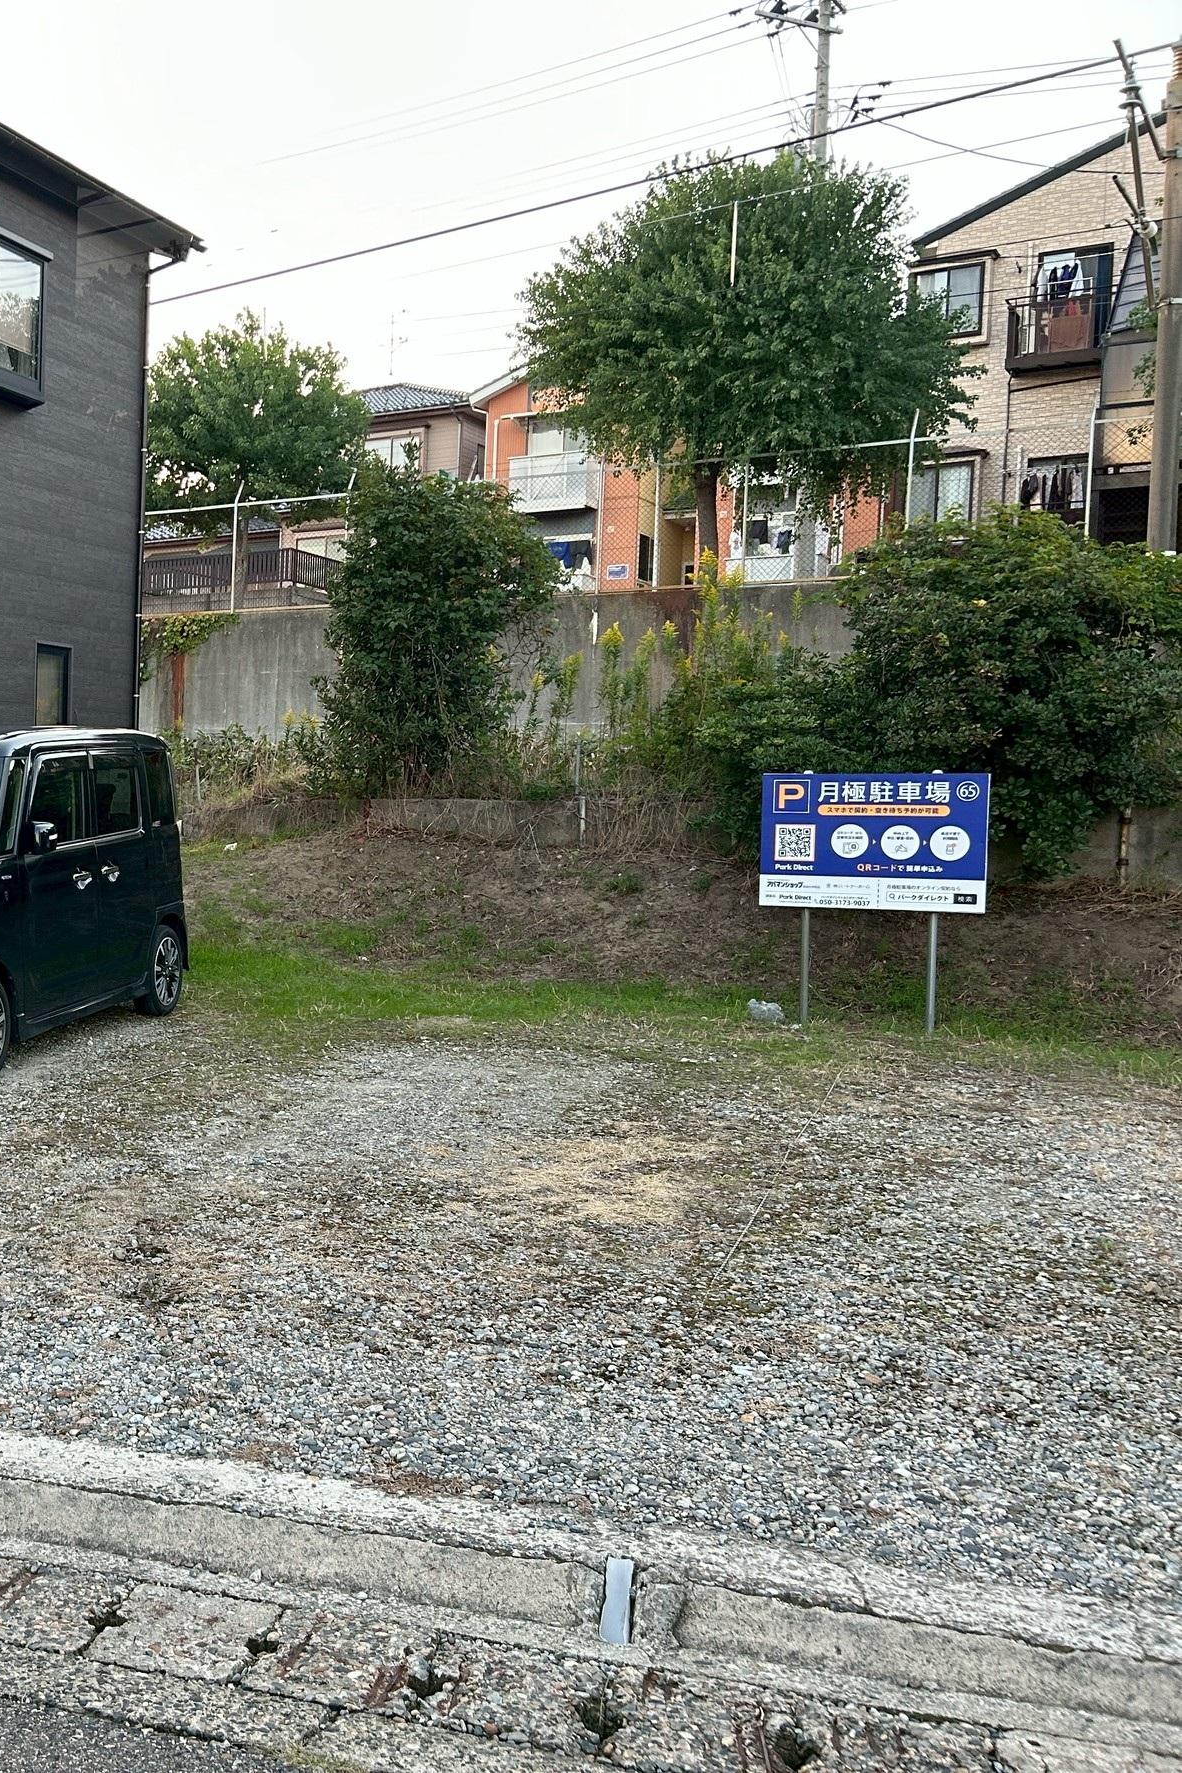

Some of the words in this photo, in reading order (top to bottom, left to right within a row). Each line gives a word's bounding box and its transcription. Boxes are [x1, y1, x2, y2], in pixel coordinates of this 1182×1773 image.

[778, 783, 805, 809] P
[817, 780, 952, 804] 月極駐車場
